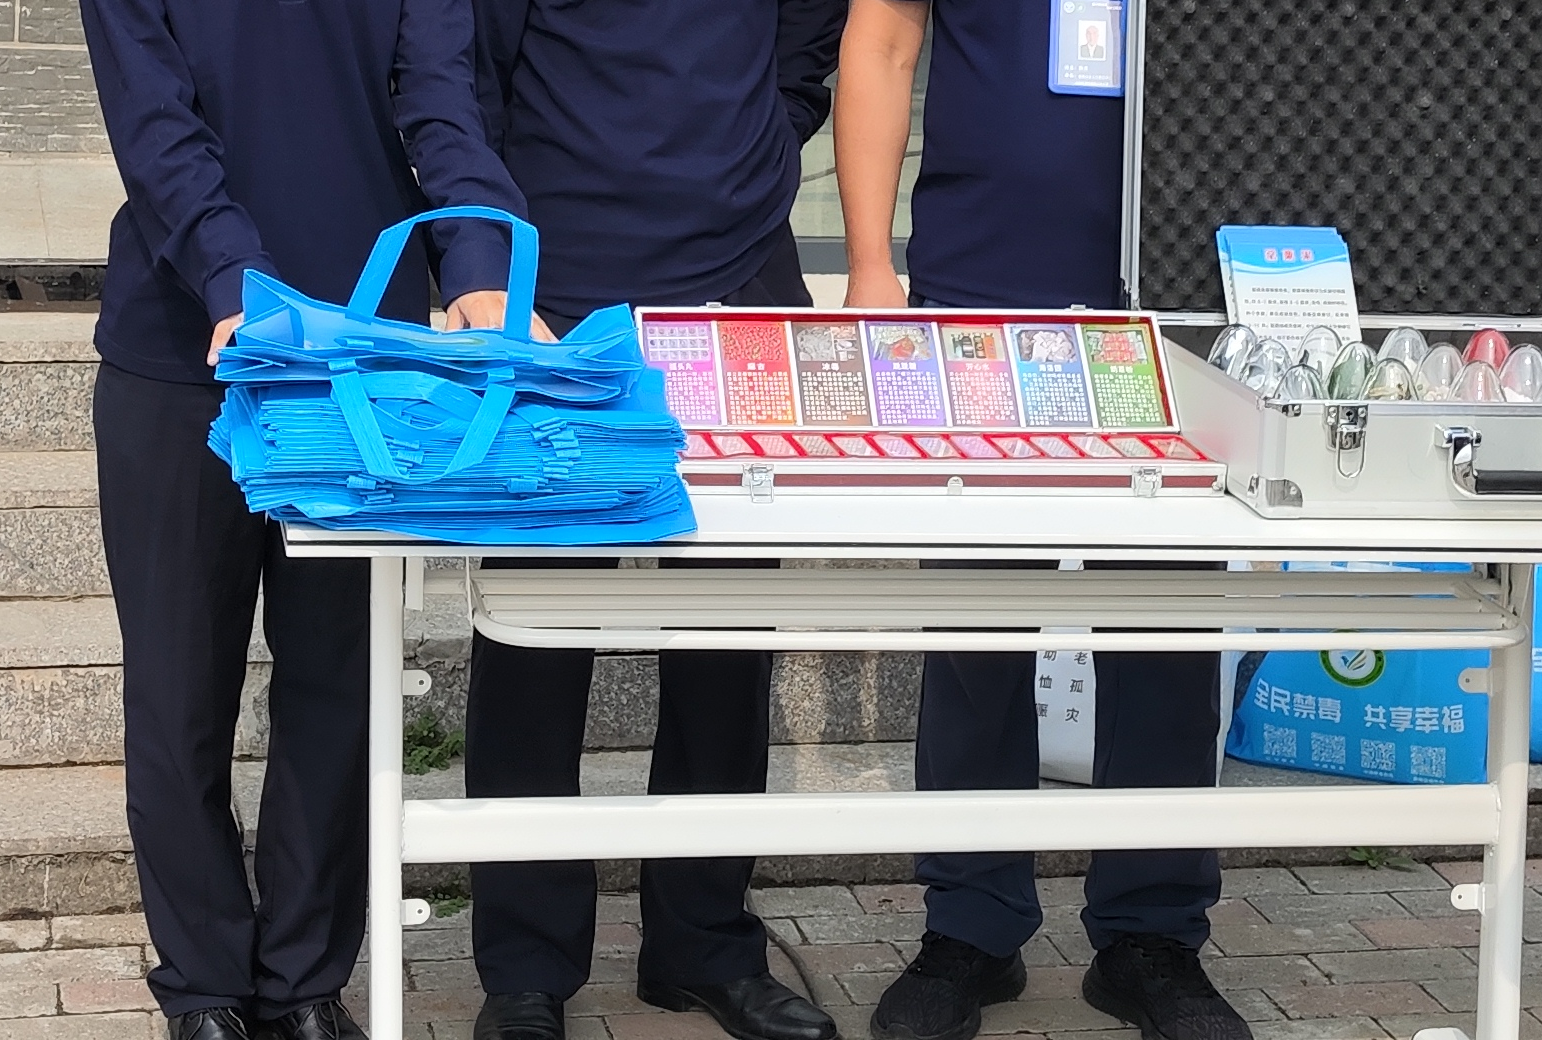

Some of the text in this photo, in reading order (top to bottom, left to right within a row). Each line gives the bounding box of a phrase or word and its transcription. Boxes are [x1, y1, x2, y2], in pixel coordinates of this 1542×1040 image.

[1253, 677, 1465, 734] 全民禁毒 共享幸福
